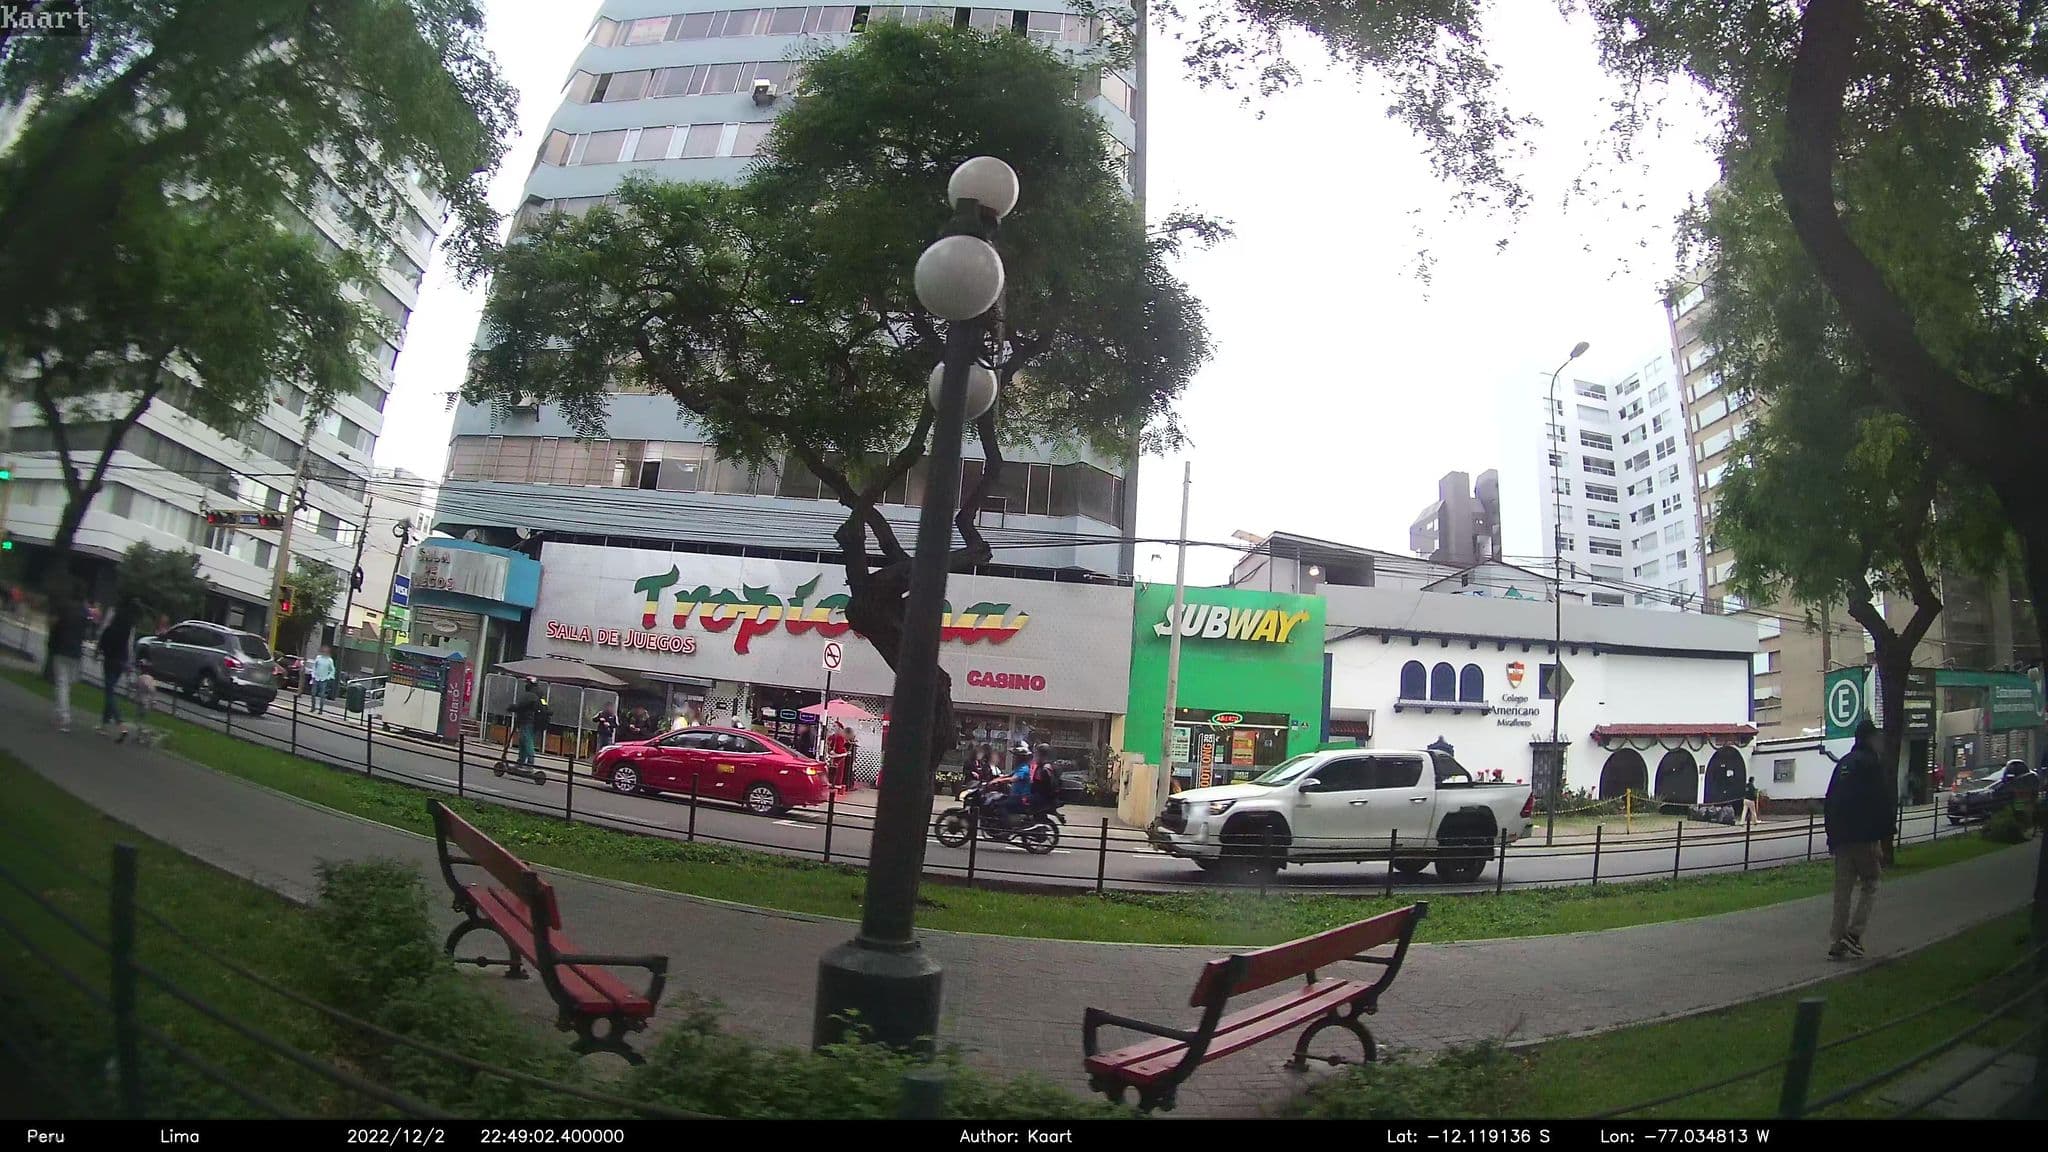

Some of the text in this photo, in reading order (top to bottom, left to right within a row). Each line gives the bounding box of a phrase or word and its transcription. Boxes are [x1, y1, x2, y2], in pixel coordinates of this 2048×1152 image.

[633, 563, 1030, 656] Tropica
[1153, 603, 1310, 643] SUBWAY
[545, 620, 696, 654] SALA DE JUEGOS
[966, 670, 1047, 691] CASINO
[449, 688, 460, 722] Claro
[1488, 705, 1540, 716] Americano
[1838, 688, 1850, 718] E
